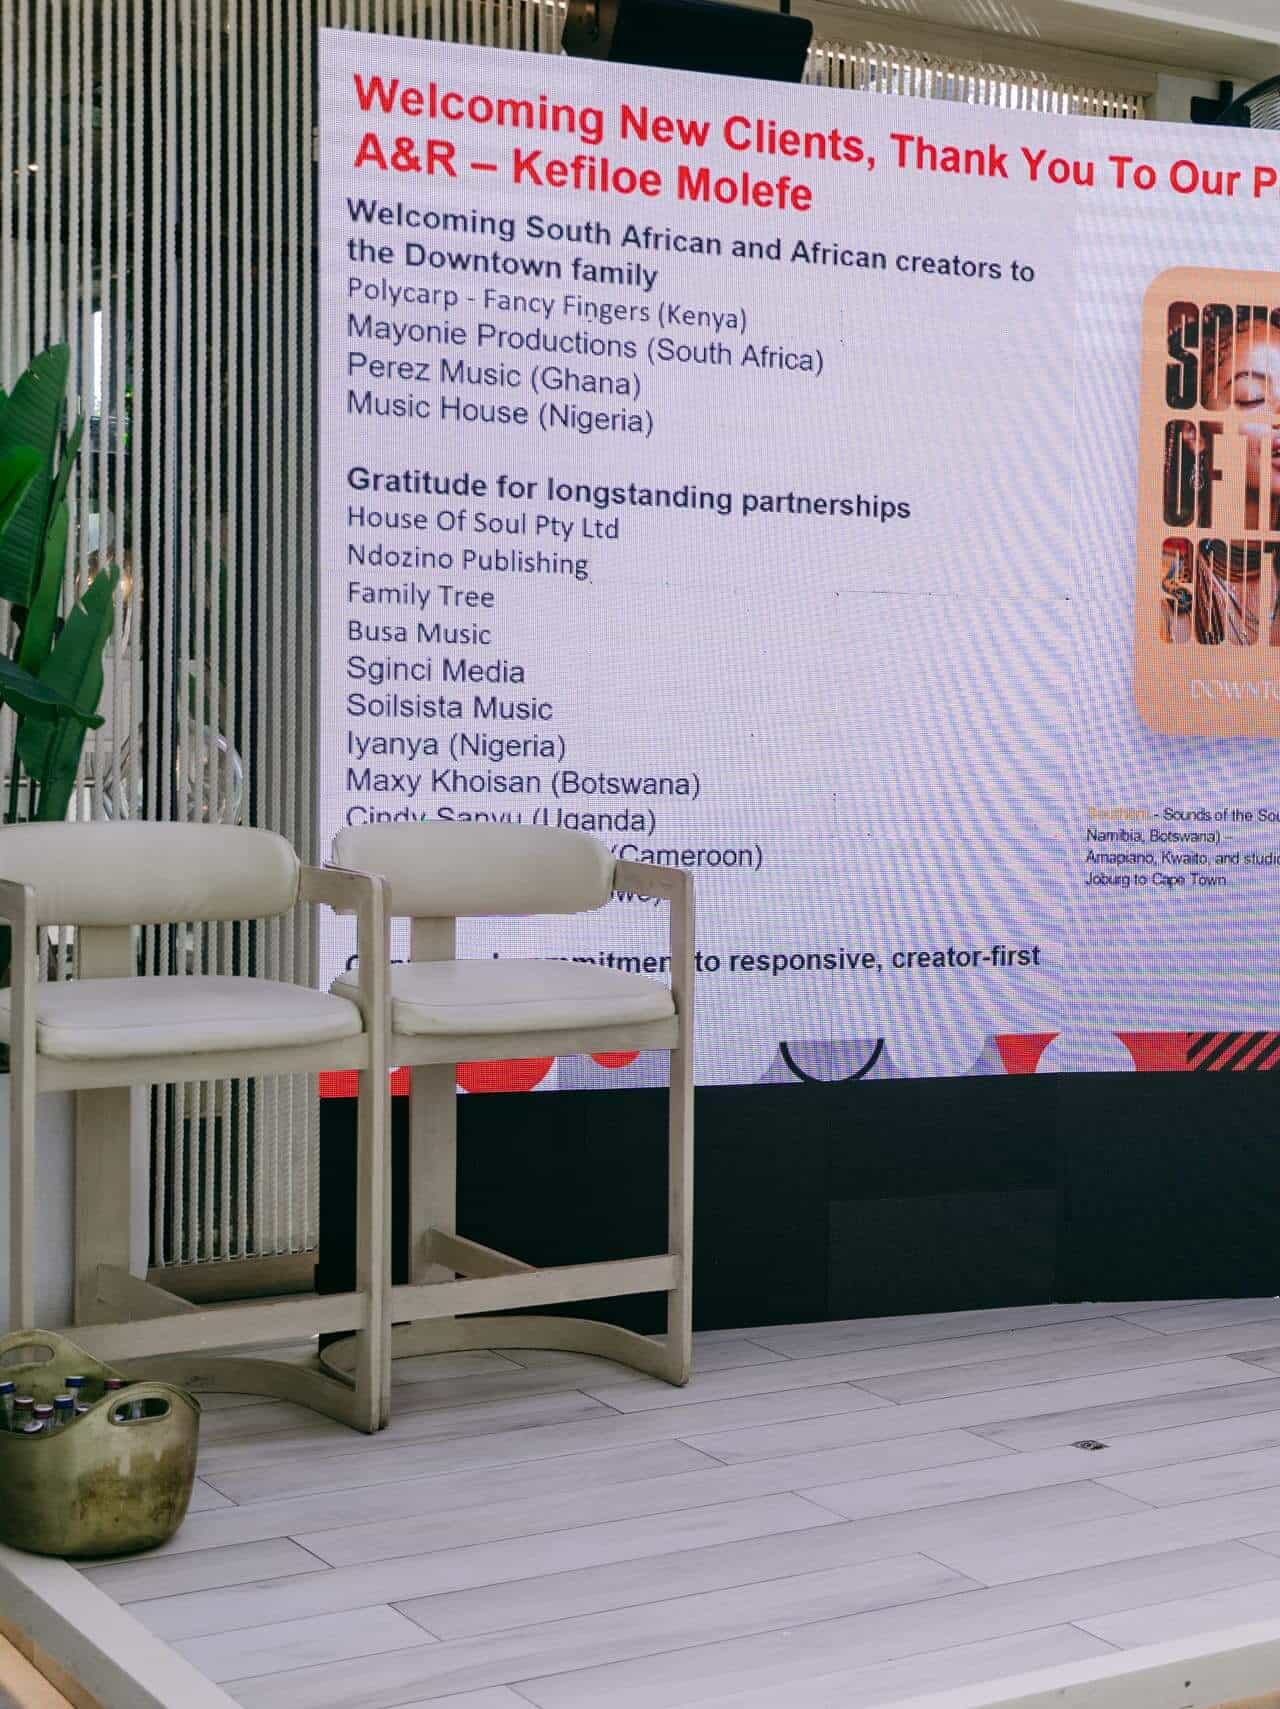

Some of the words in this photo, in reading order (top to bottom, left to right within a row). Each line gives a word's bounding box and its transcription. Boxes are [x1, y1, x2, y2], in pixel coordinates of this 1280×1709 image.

[353, 74, 604, 146] Welcoming
[620, 103, 711, 148] New
[723, 115, 876, 172] Clients,
[889, 132, 1009, 179] Thank
[1020, 146, 1095, 187] You
[1107, 154, 1157, 191] To
[1169, 159, 1242, 197] Our
[354, 132, 457, 178] A&R
[513, 147, 662, 197] Kefiloe
[677, 164, 813, 212] Molefe
[346, 197, 516, 243] Welcoming
[526, 214, 611, 246] South
[620, 224, 722, 256] African
[731, 237, 782, 261] and
[790, 239, 887, 270] African
[895, 254, 1003, 280] creators
[1010, 260, 1036, 283] to
[347, 238, 395, 265] the
[405, 241, 562, 279] Downtown
[571, 256, 659, 293] family
[349, 277, 459, 312] Polycarp
[484, 288, 555, 320] Fancy
[563, 295, 650, 325] Fingers
[658, 302, 747, 335] (Kenya)
[348, 313, 467, 347] Mayonie
[477, 323, 637, 359] Productions
[647, 337, 732, 366] (South
[740, 343, 824, 377] Africa)
[348, 351, 430, 382] Perez
[440, 358, 521, 388] Music
[530, 366, 641, 401] (Ghana)
[348, 389, 430, 419] Music
[440, 395, 529, 425] House
[538, 402, 654, 439] (Nigeria)
[347, 466, 488, 498] Gratitude
[496, 474, 538, 500] for
[547, 476, 733, 516] longstanding
[742, 491, 912, 524] partnerships
[348, 506, 428, 530] House
[436, 508, 467, 532] Of
[473, 511, 526, 535] Soul
[535, 514, 575, 543] Pty
[582, 517, 619, 540] Ltd
[348, 543, 454, 570] Ndozino
[462, 548, 589, 582] Publishing
[348, 581, 431, 611] Family
[438, 584, 495, 609] Tree
[348, 620, 408, 643] Busa
[417, 622, 491, 646] Music
[347, 655, 432, 686] Sginci
[442, 657, 525, 684] Media
[347, 692, 463, 719] Soilsista
[473, 695, 553, 721] Music
[348, 730, 439, 761] Iyanya
[449, 732, 566, 763] (Nigeria)
[347, 767, 422, 798] Maxy
[432, 769, 541, 793] Khoisan
[551, 770, 701, 801] (Botswana)
[1164, 808, 1211, 821] Sounds
[1215, 808, 1229, 822] of
[1232, 809, 1253, 822] the
[1087, 829, 1145, 843] Namibia,
[1150, 829, 1220, 843] Botswana)
[1215, 852, 1239, 865] and
[1087, 873, 1130, 888] Joburg
[1135, 874, 1147, 885] to
[1153, 874, 1185, 889] Cape
[1191, 874, 1226, 886] Town
[695, 951, 720, 972] to
[730, 948, 882, 976] responsive,
[892, 945, 1041, 969] creator-first
